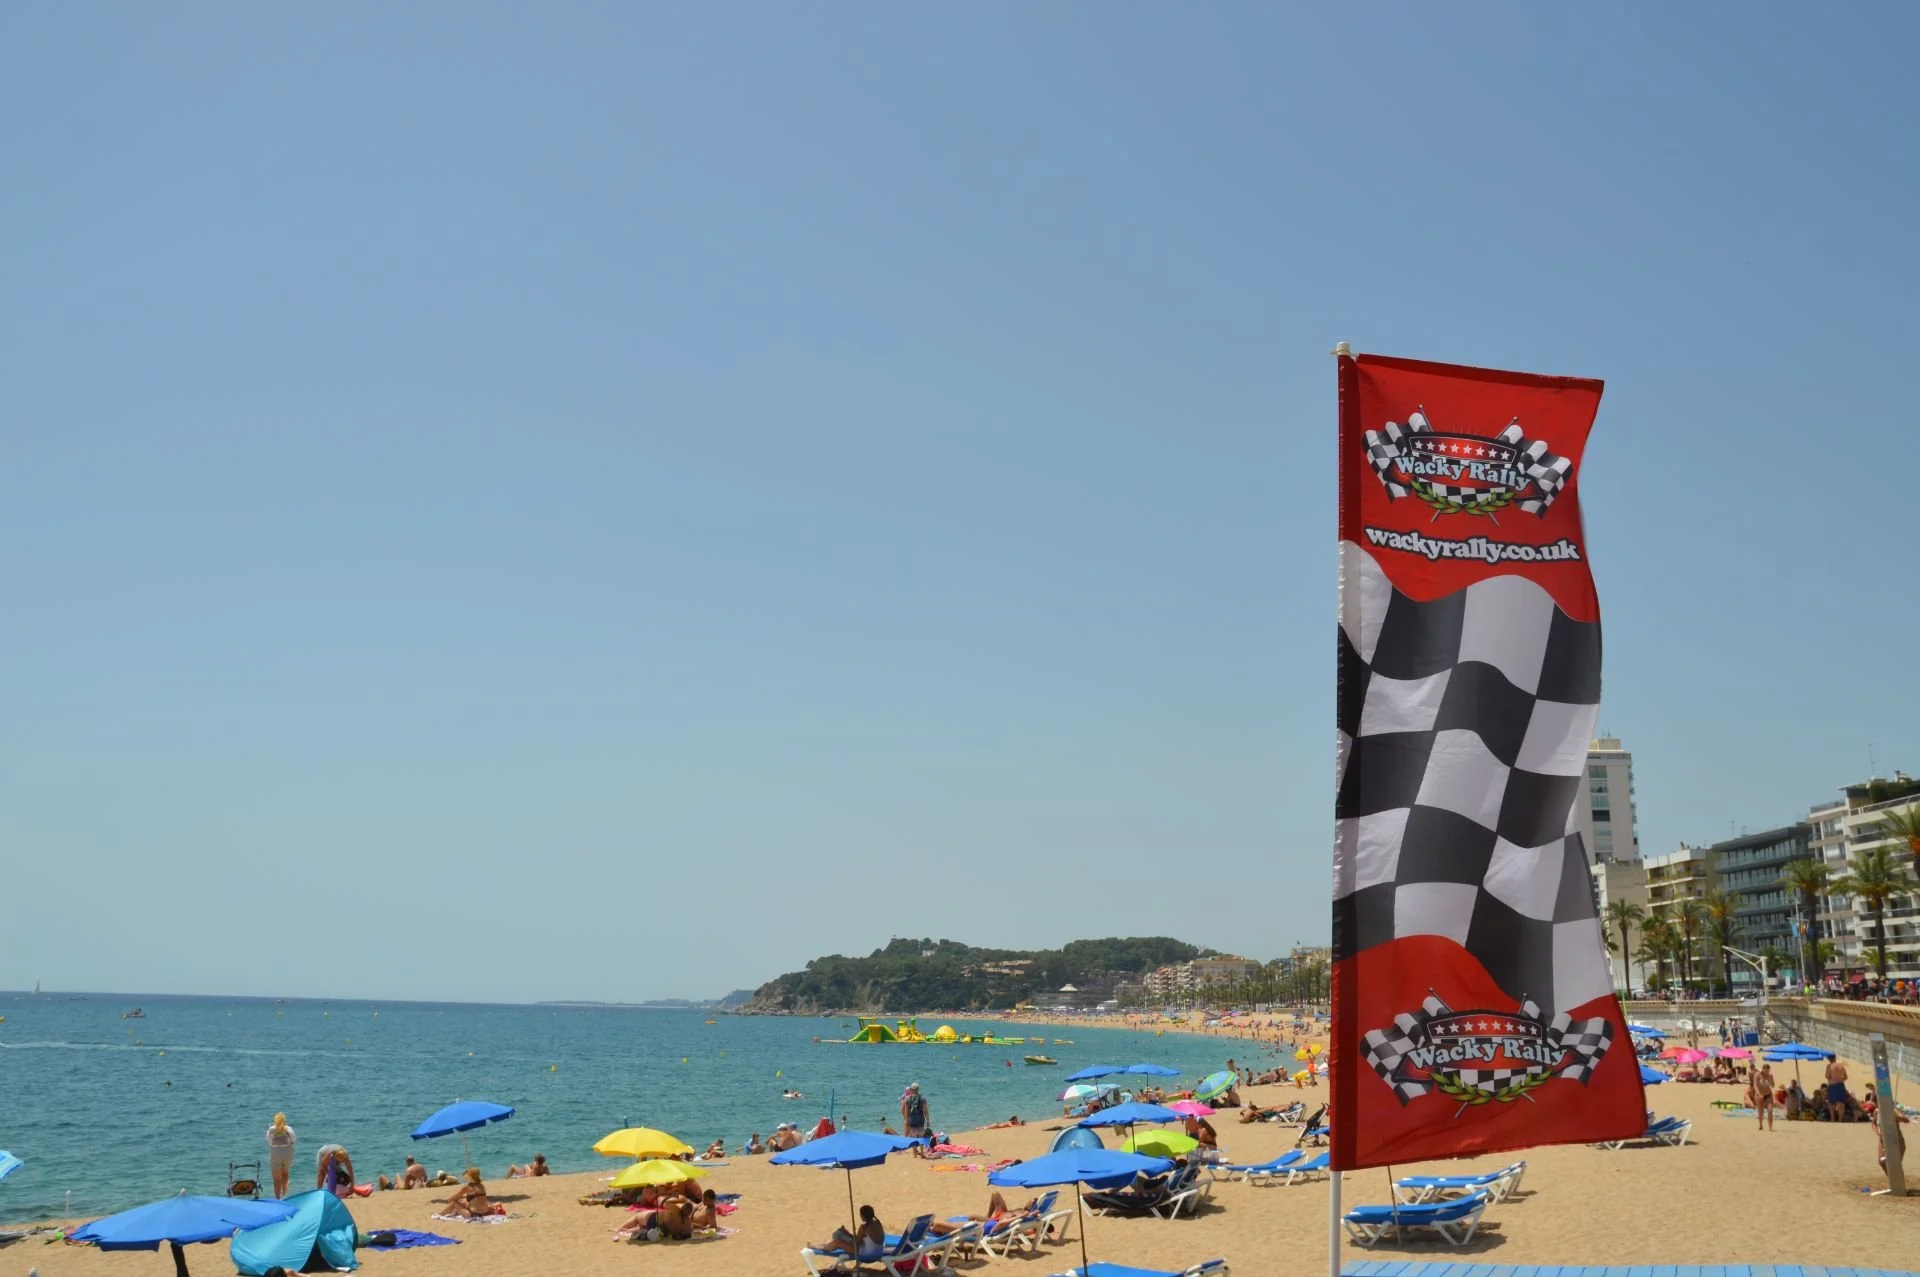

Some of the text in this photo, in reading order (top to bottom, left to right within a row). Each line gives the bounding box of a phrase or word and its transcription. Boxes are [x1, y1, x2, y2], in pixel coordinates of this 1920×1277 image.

[1395, 456, 1531, 490] Wacky Rally
[1365, 528, 1580, 563] wackyrally.co.uk
[1408, 1039, 1566, 1068] Wacky Rally
